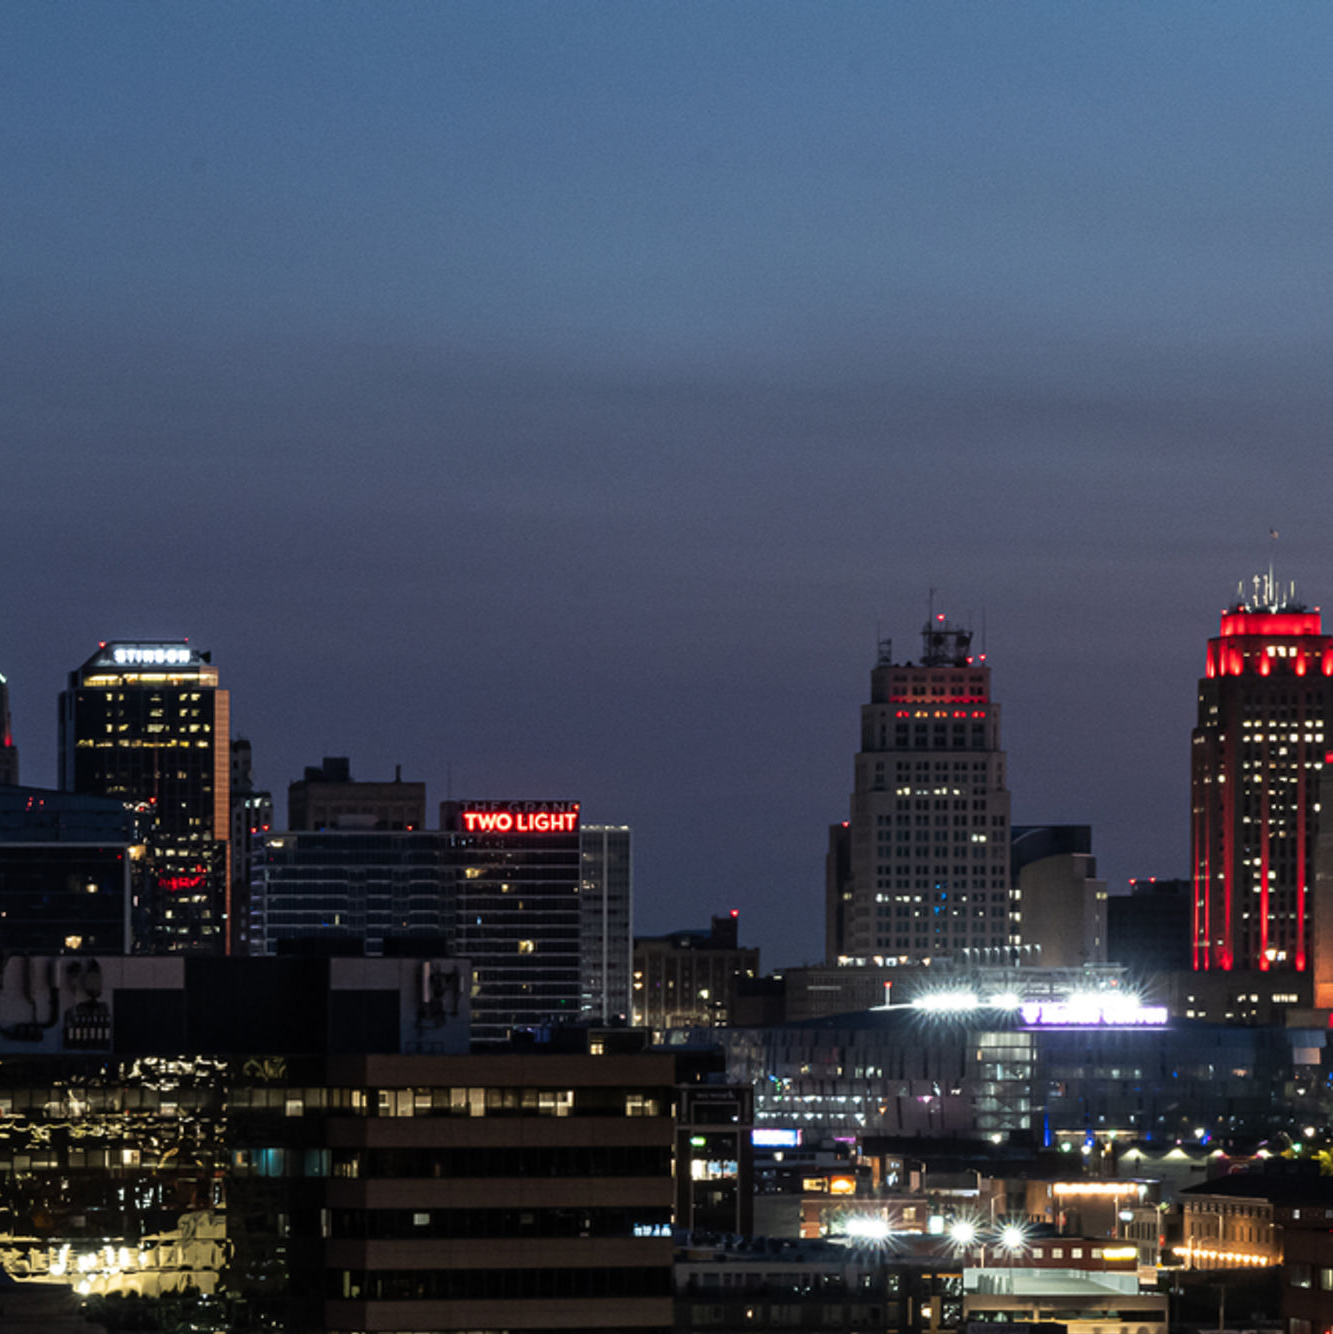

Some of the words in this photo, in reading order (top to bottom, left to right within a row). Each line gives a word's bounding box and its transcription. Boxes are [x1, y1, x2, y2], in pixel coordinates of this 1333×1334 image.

[114, 648, 190, 664] STINSON
[464, 813, 512, 832] TWO
[517, 813, 577, 832] LIGHT
